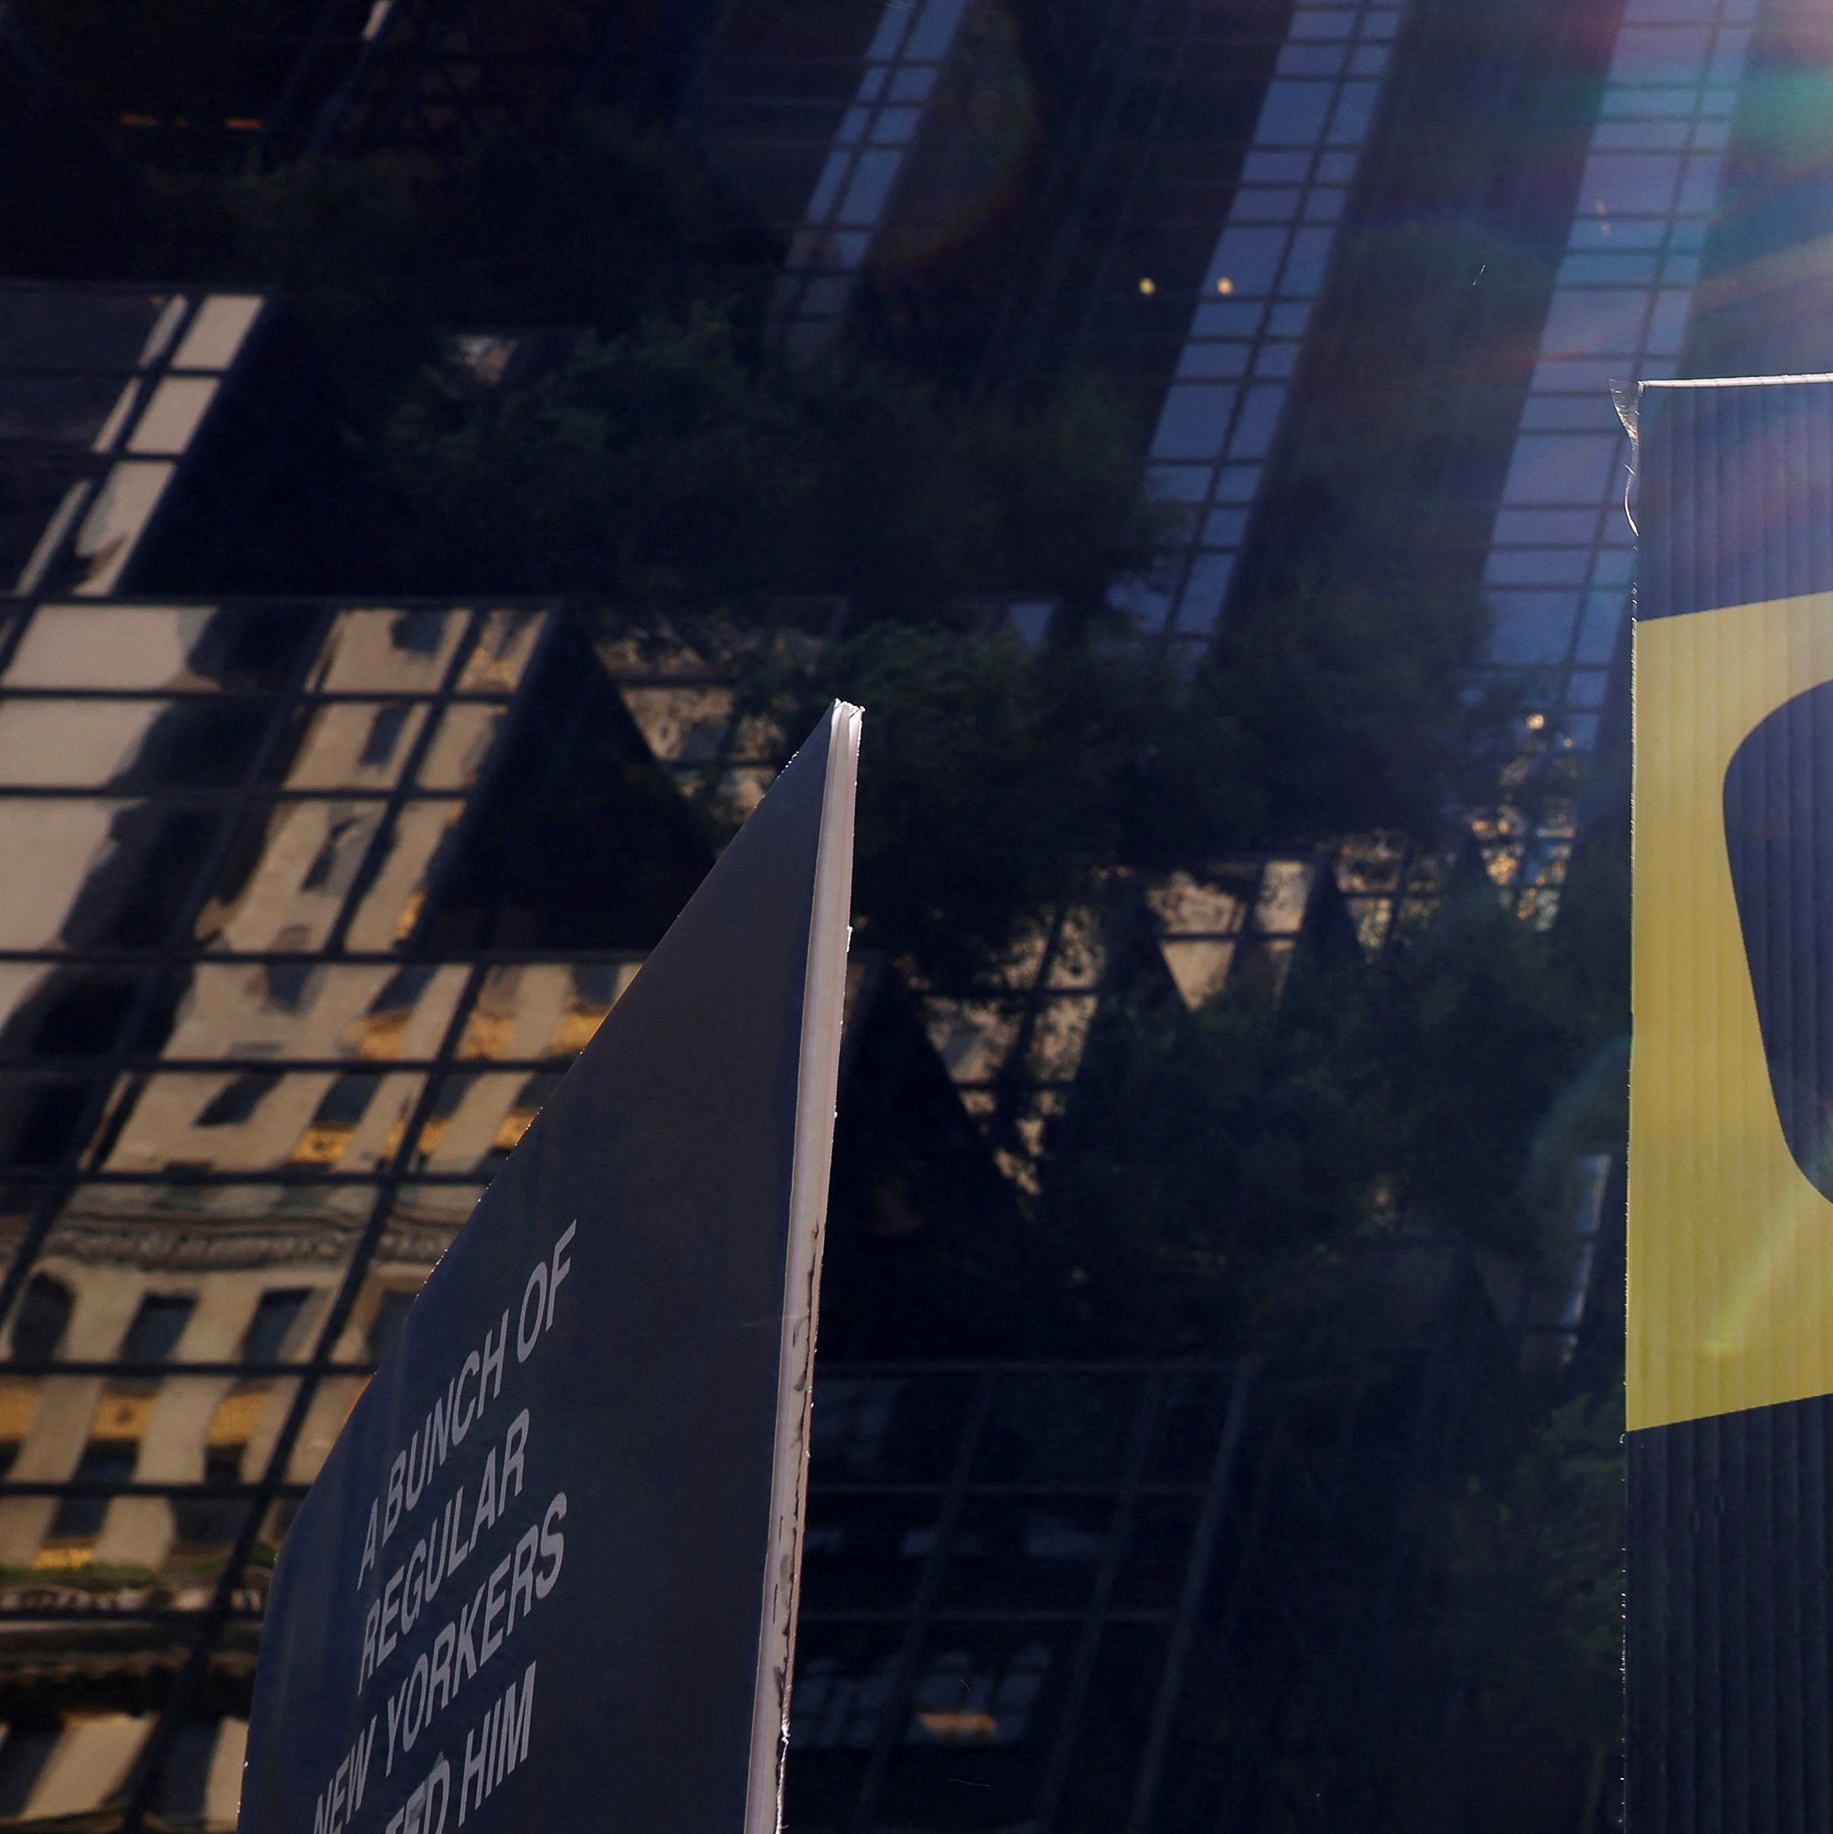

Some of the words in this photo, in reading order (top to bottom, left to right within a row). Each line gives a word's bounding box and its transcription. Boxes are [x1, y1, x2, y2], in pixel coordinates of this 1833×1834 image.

[356, 1496, 380, 1591] A
[382, 1307, 510, 1541] BUNCH
[516, 1217, 579, 1364] OF
[357, 1407, 530, 1697] REGULAR
[384, 1490, 567, 1778] YORKERS
[457, 1660, 536, 1829] HIM
